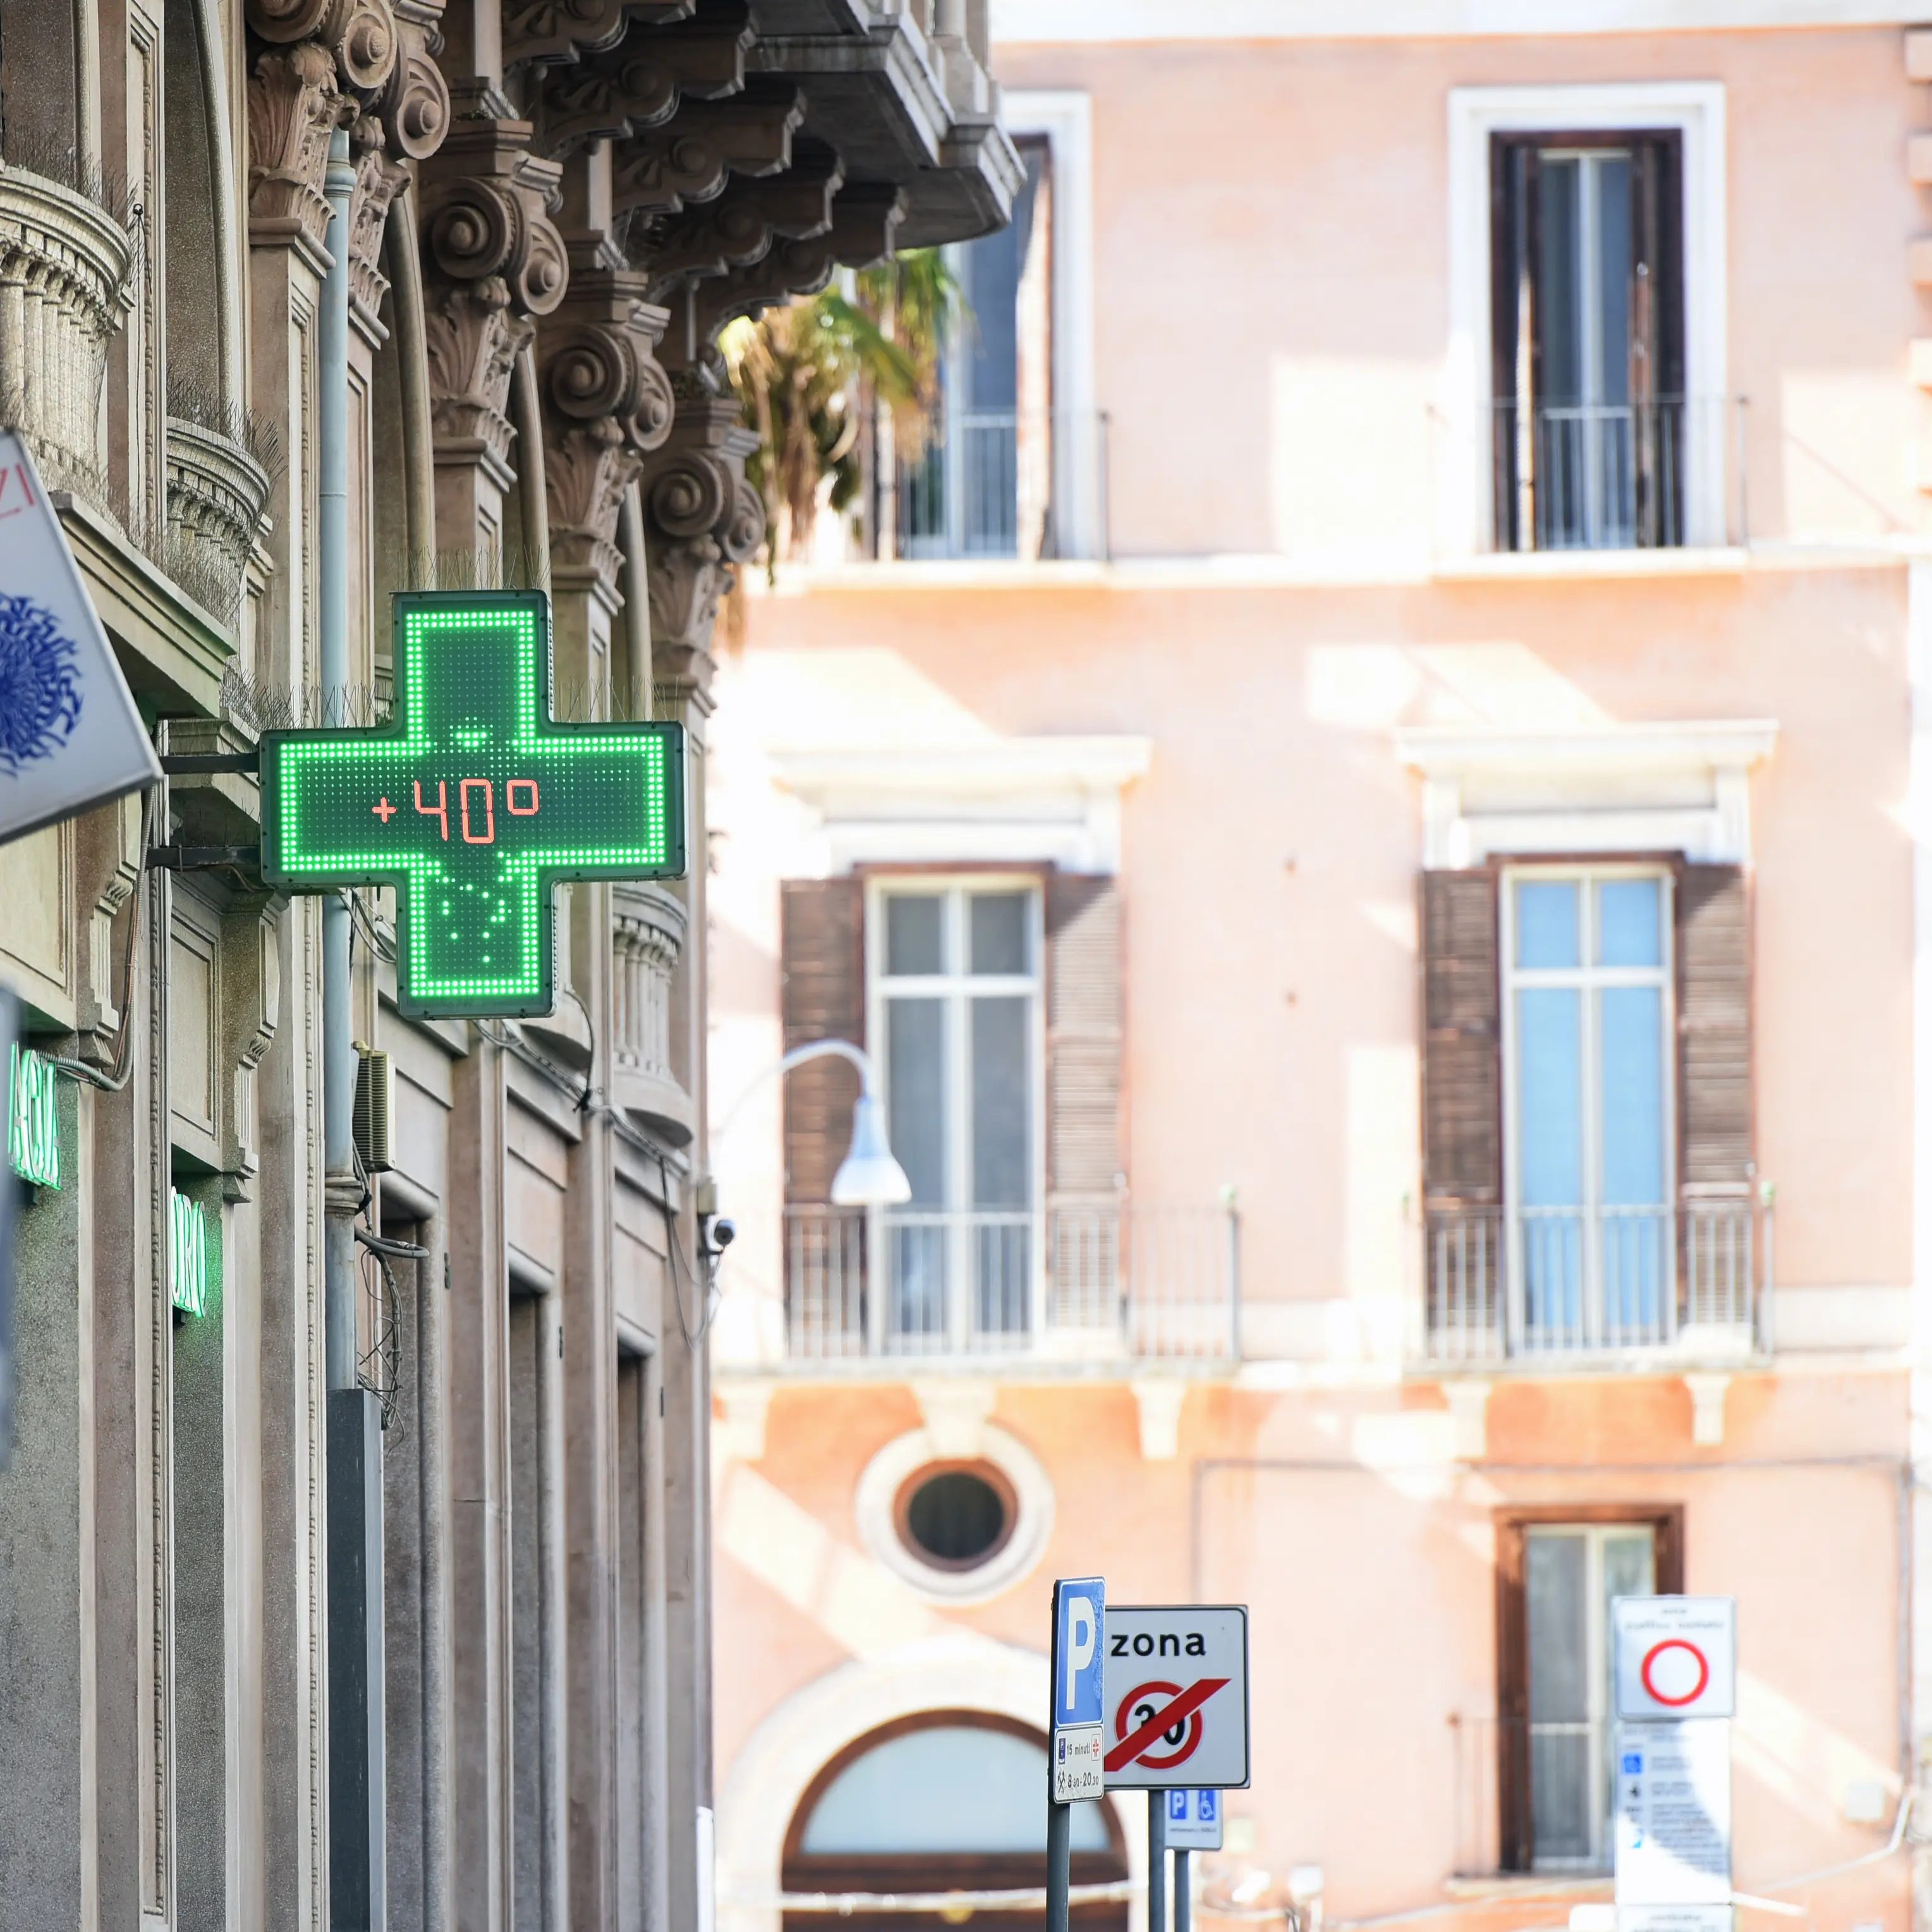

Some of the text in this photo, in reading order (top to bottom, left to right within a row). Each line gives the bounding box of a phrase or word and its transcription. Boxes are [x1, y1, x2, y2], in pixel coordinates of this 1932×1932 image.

[1066, 1596, 1096, 1710] P
[1110, 1632, 1206, 1656] zona
[1067, 1742, 1090, 1756] 15 minuti
[1172, 1792, 1185, 1816] P
